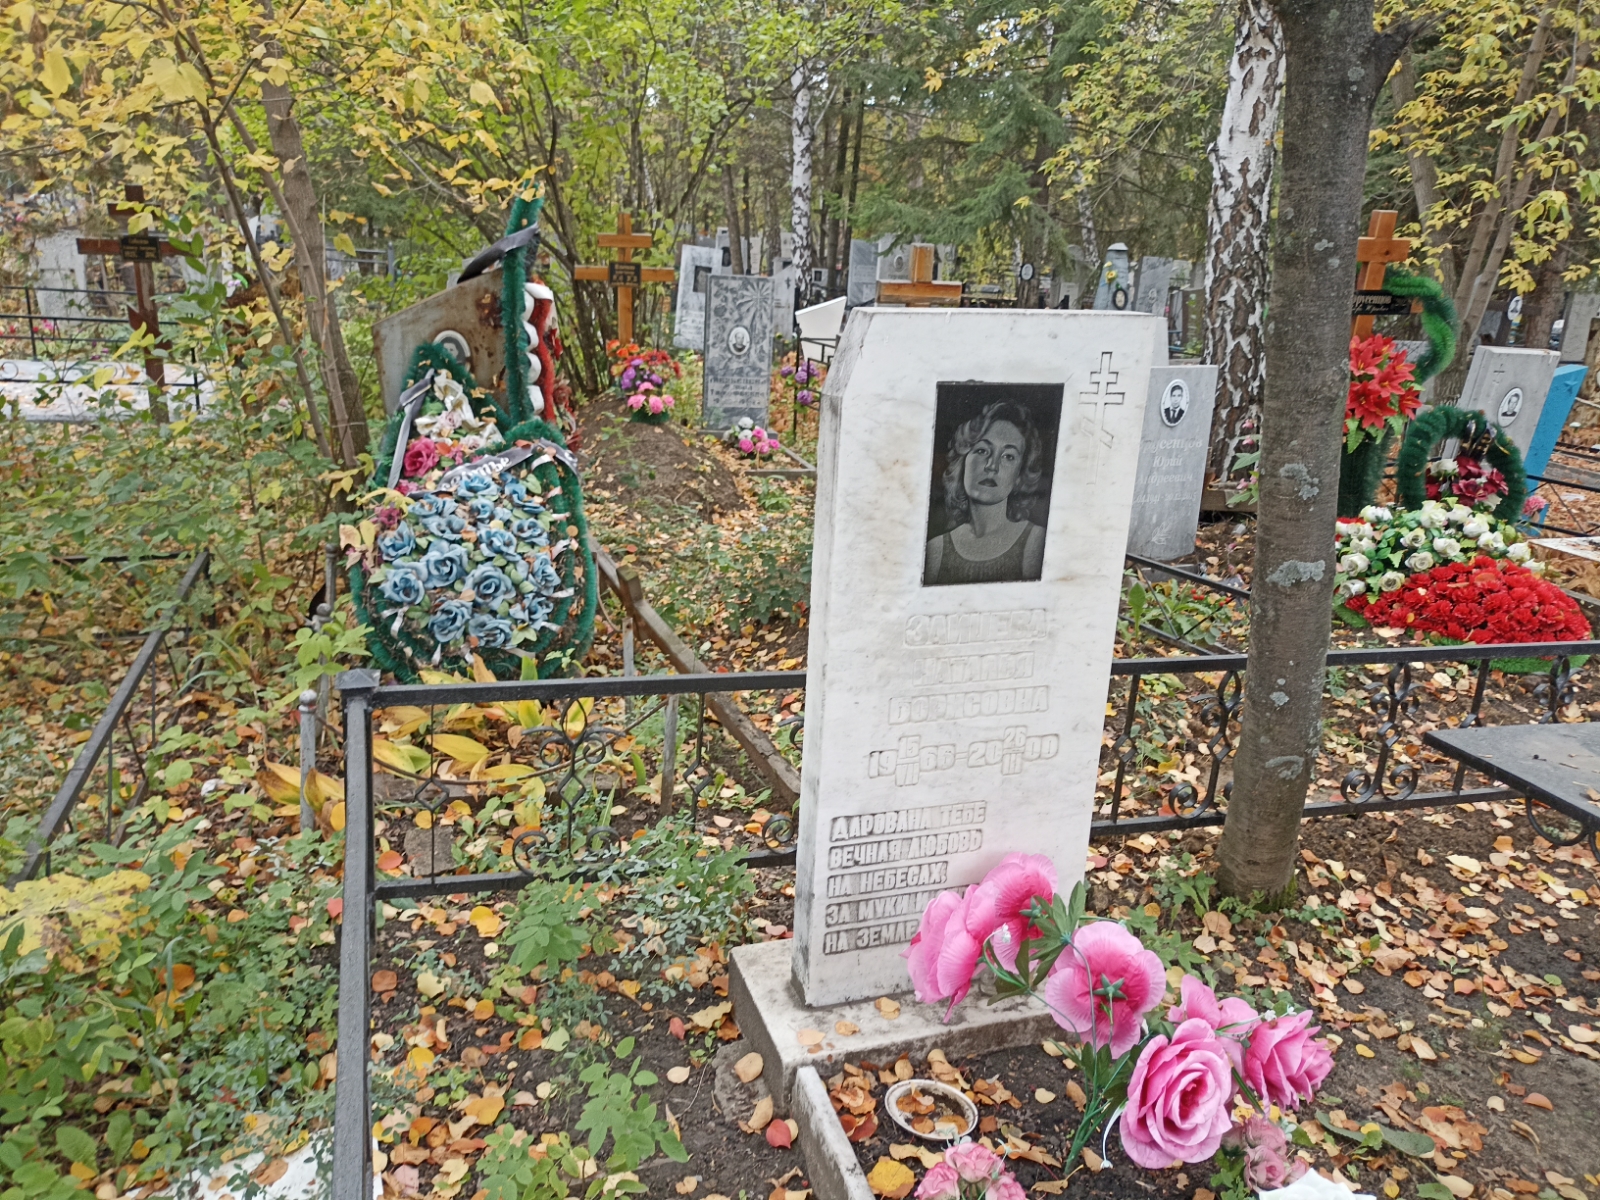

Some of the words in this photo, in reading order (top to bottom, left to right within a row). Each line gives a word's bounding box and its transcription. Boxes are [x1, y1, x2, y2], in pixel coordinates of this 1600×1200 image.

[1139, 437, 1203, 453] русенцов
[1153, 455, 1183, 470] Юрий
[888, 686, 1050, 725] БОРИСОВНА
[831, 809, 933, 842] ДАРОВАНА
[940, 801, 987, 828] ТЕБЕ
[829, 839, 900, 870] ВЕЧНАЯ
[908, 829, 983, 859] ЛЮБОВЬ
[828, 873, 852, 898] НА
[825, 903, 851, 927] ЗА
[858, 893, 905, 921] МУКИ
[824, 930, 849, 955] НА
